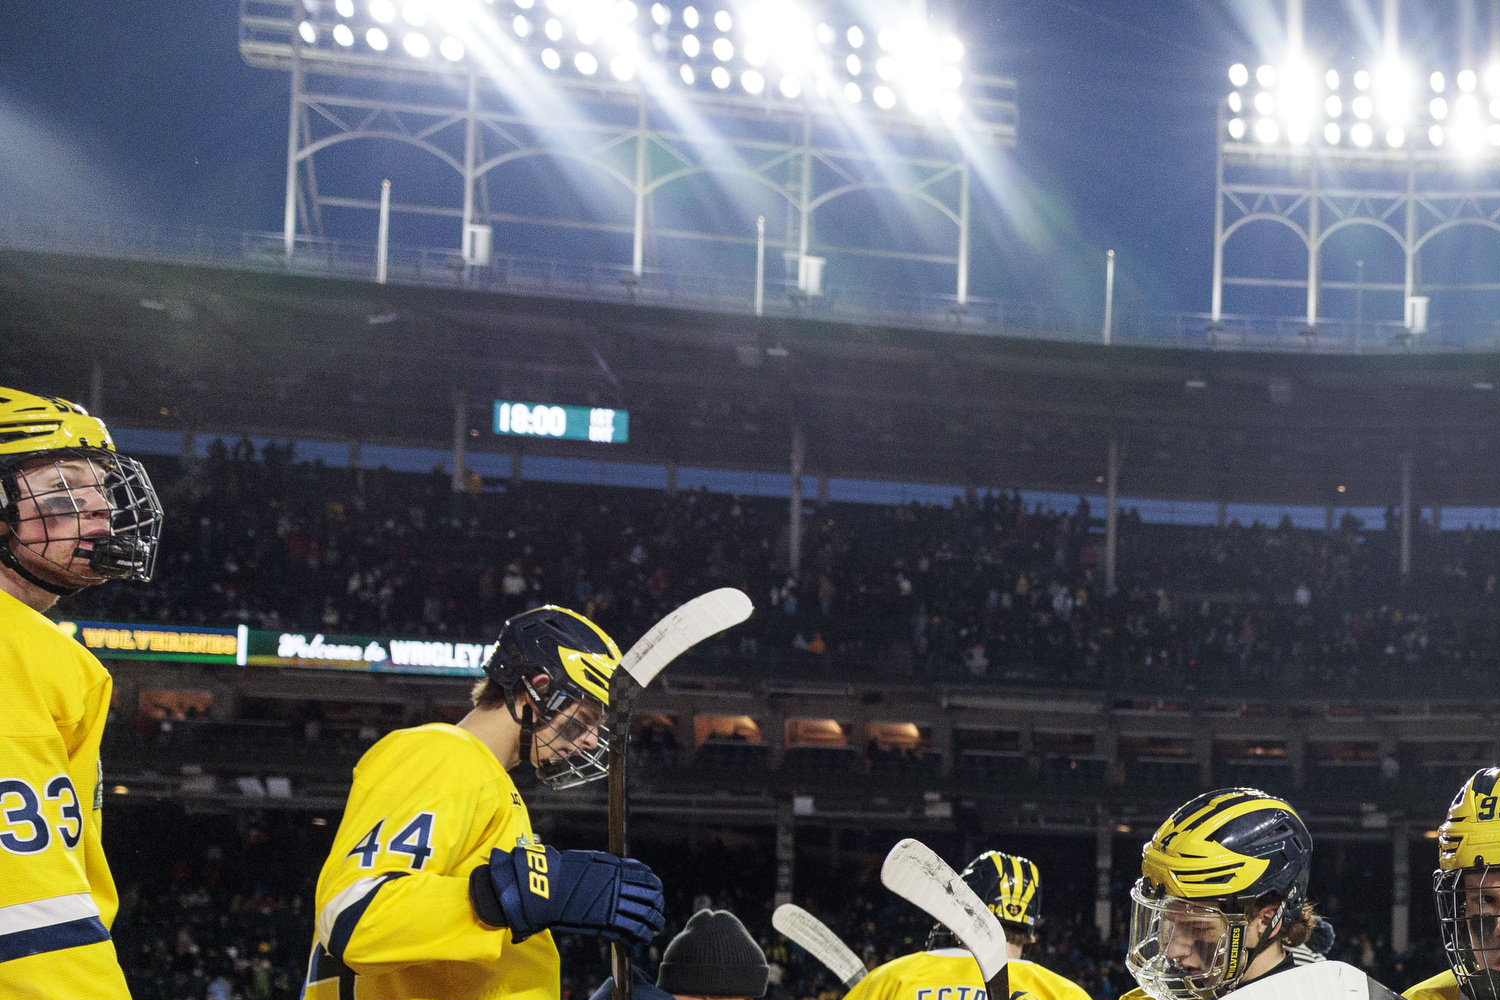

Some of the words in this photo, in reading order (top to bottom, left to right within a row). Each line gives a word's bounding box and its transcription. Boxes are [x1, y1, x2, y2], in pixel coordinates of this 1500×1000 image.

[499, 402, 567, 437] 18:00
[83, 628, 238, 655] WOLVERINES
[278, 633, 363, 661] Welcome
[363, 641, 387, 663] to
[389, 639, 481, 669] WRIGLEY
[0, 774, 84, 855] 33
[345, 811, 437, 871] 44
[1160, 831, 1180, 851] 4
[1225, 927, 1241, 980] WOLVERINES
